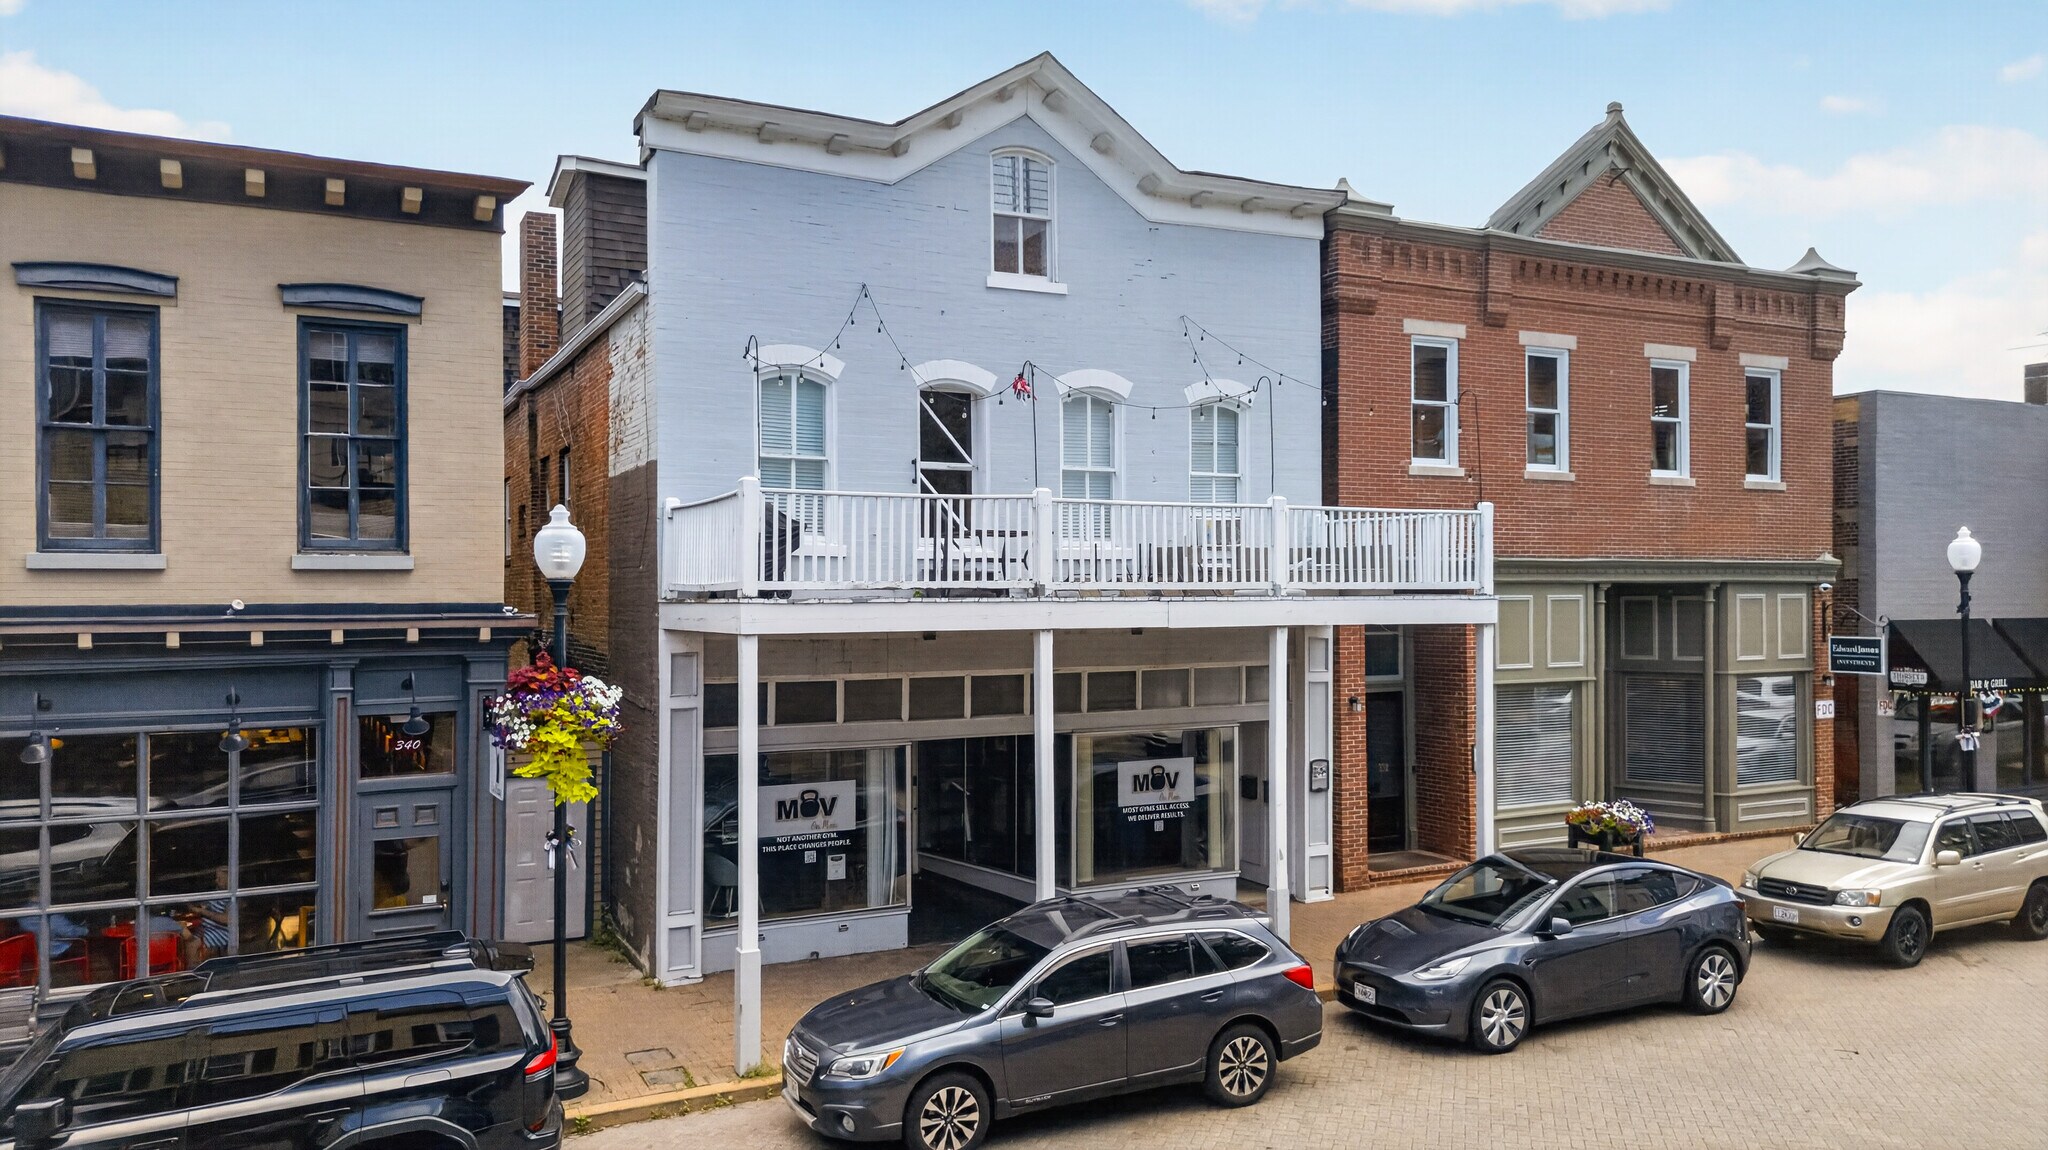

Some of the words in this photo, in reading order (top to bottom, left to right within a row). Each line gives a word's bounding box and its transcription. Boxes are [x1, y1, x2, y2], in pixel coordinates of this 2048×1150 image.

[1970, 680, 1982, 689] BAR
[1984, 680, 1990, 688] &
[1990, 678, 2008, 688] GRILL
[1816, 703, 1833, 716] FDC
[1880, 700, 1893, 710] FDC
[395, 740, 421, 750] 340
[1139, 804, 1155, 813] GYMS
[1138, 813, 1160, 821] DELIVER
[792, 833, 821, 842] ANOTHER
[777, 843, 797, 852] PLACE
[797, 840, 827, 850] CHANGES
